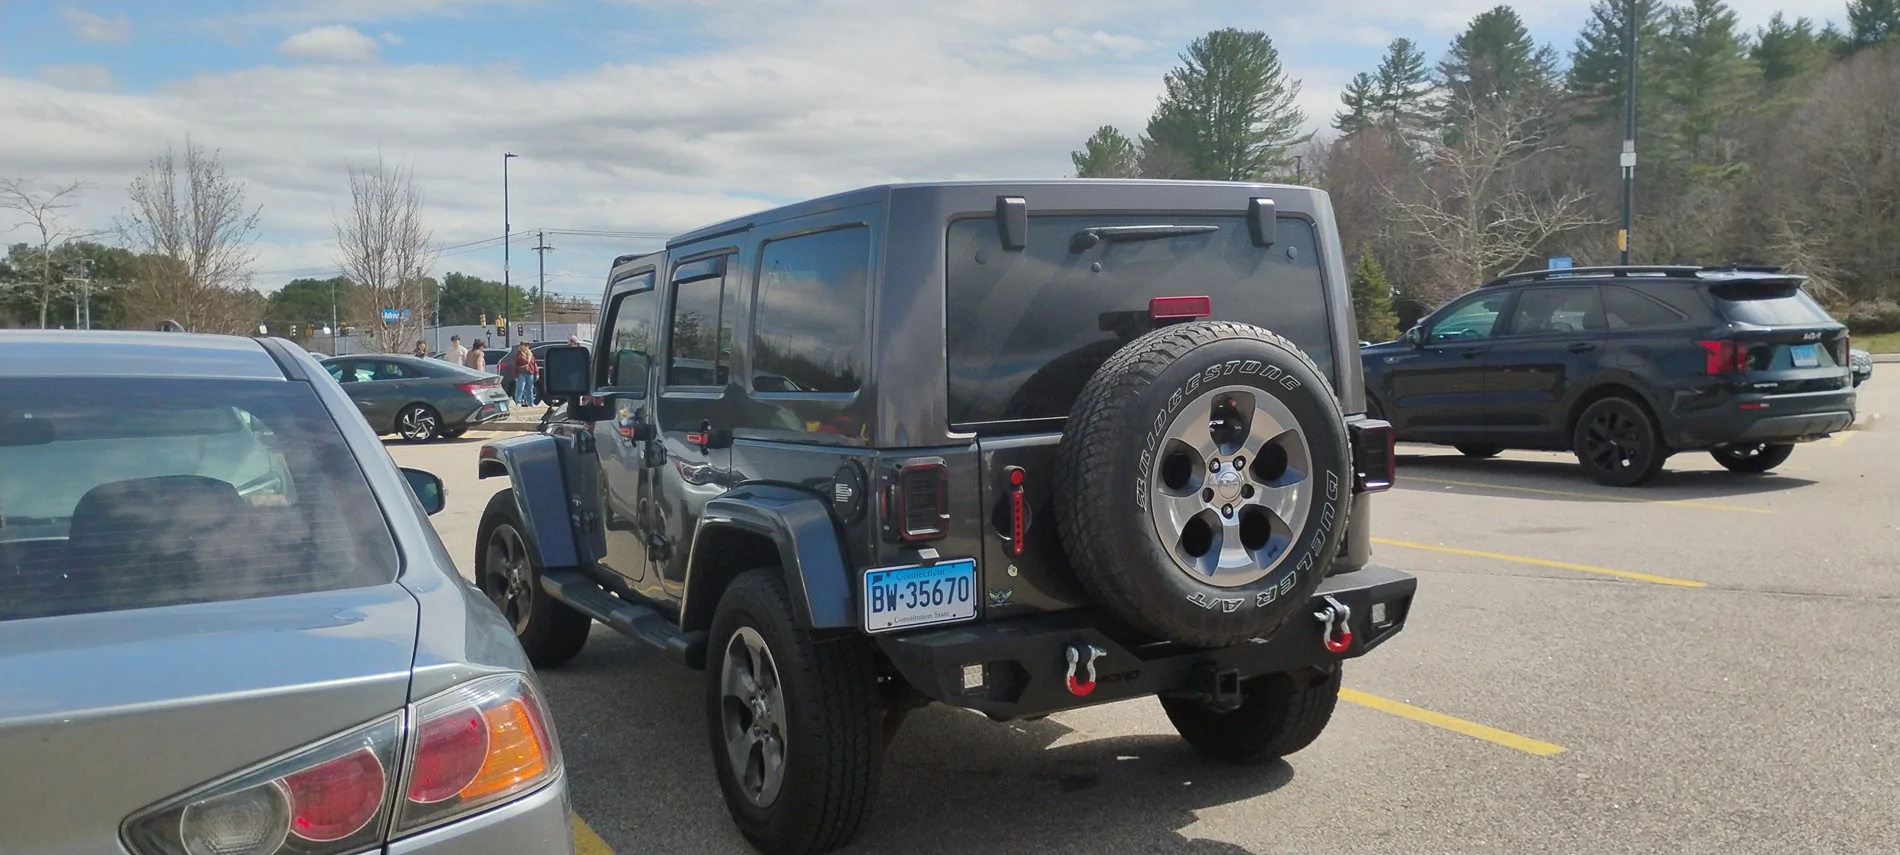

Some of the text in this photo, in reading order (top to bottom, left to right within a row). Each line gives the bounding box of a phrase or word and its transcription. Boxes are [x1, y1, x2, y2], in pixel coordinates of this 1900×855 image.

[1135, 359, 1301, 513] BRIDGESTONE
[896, 569, 946, 581] Connecticut
[1187, 470, 1339, 613] DUELER A/T
[894, 611, 950, 624] Constitution State
